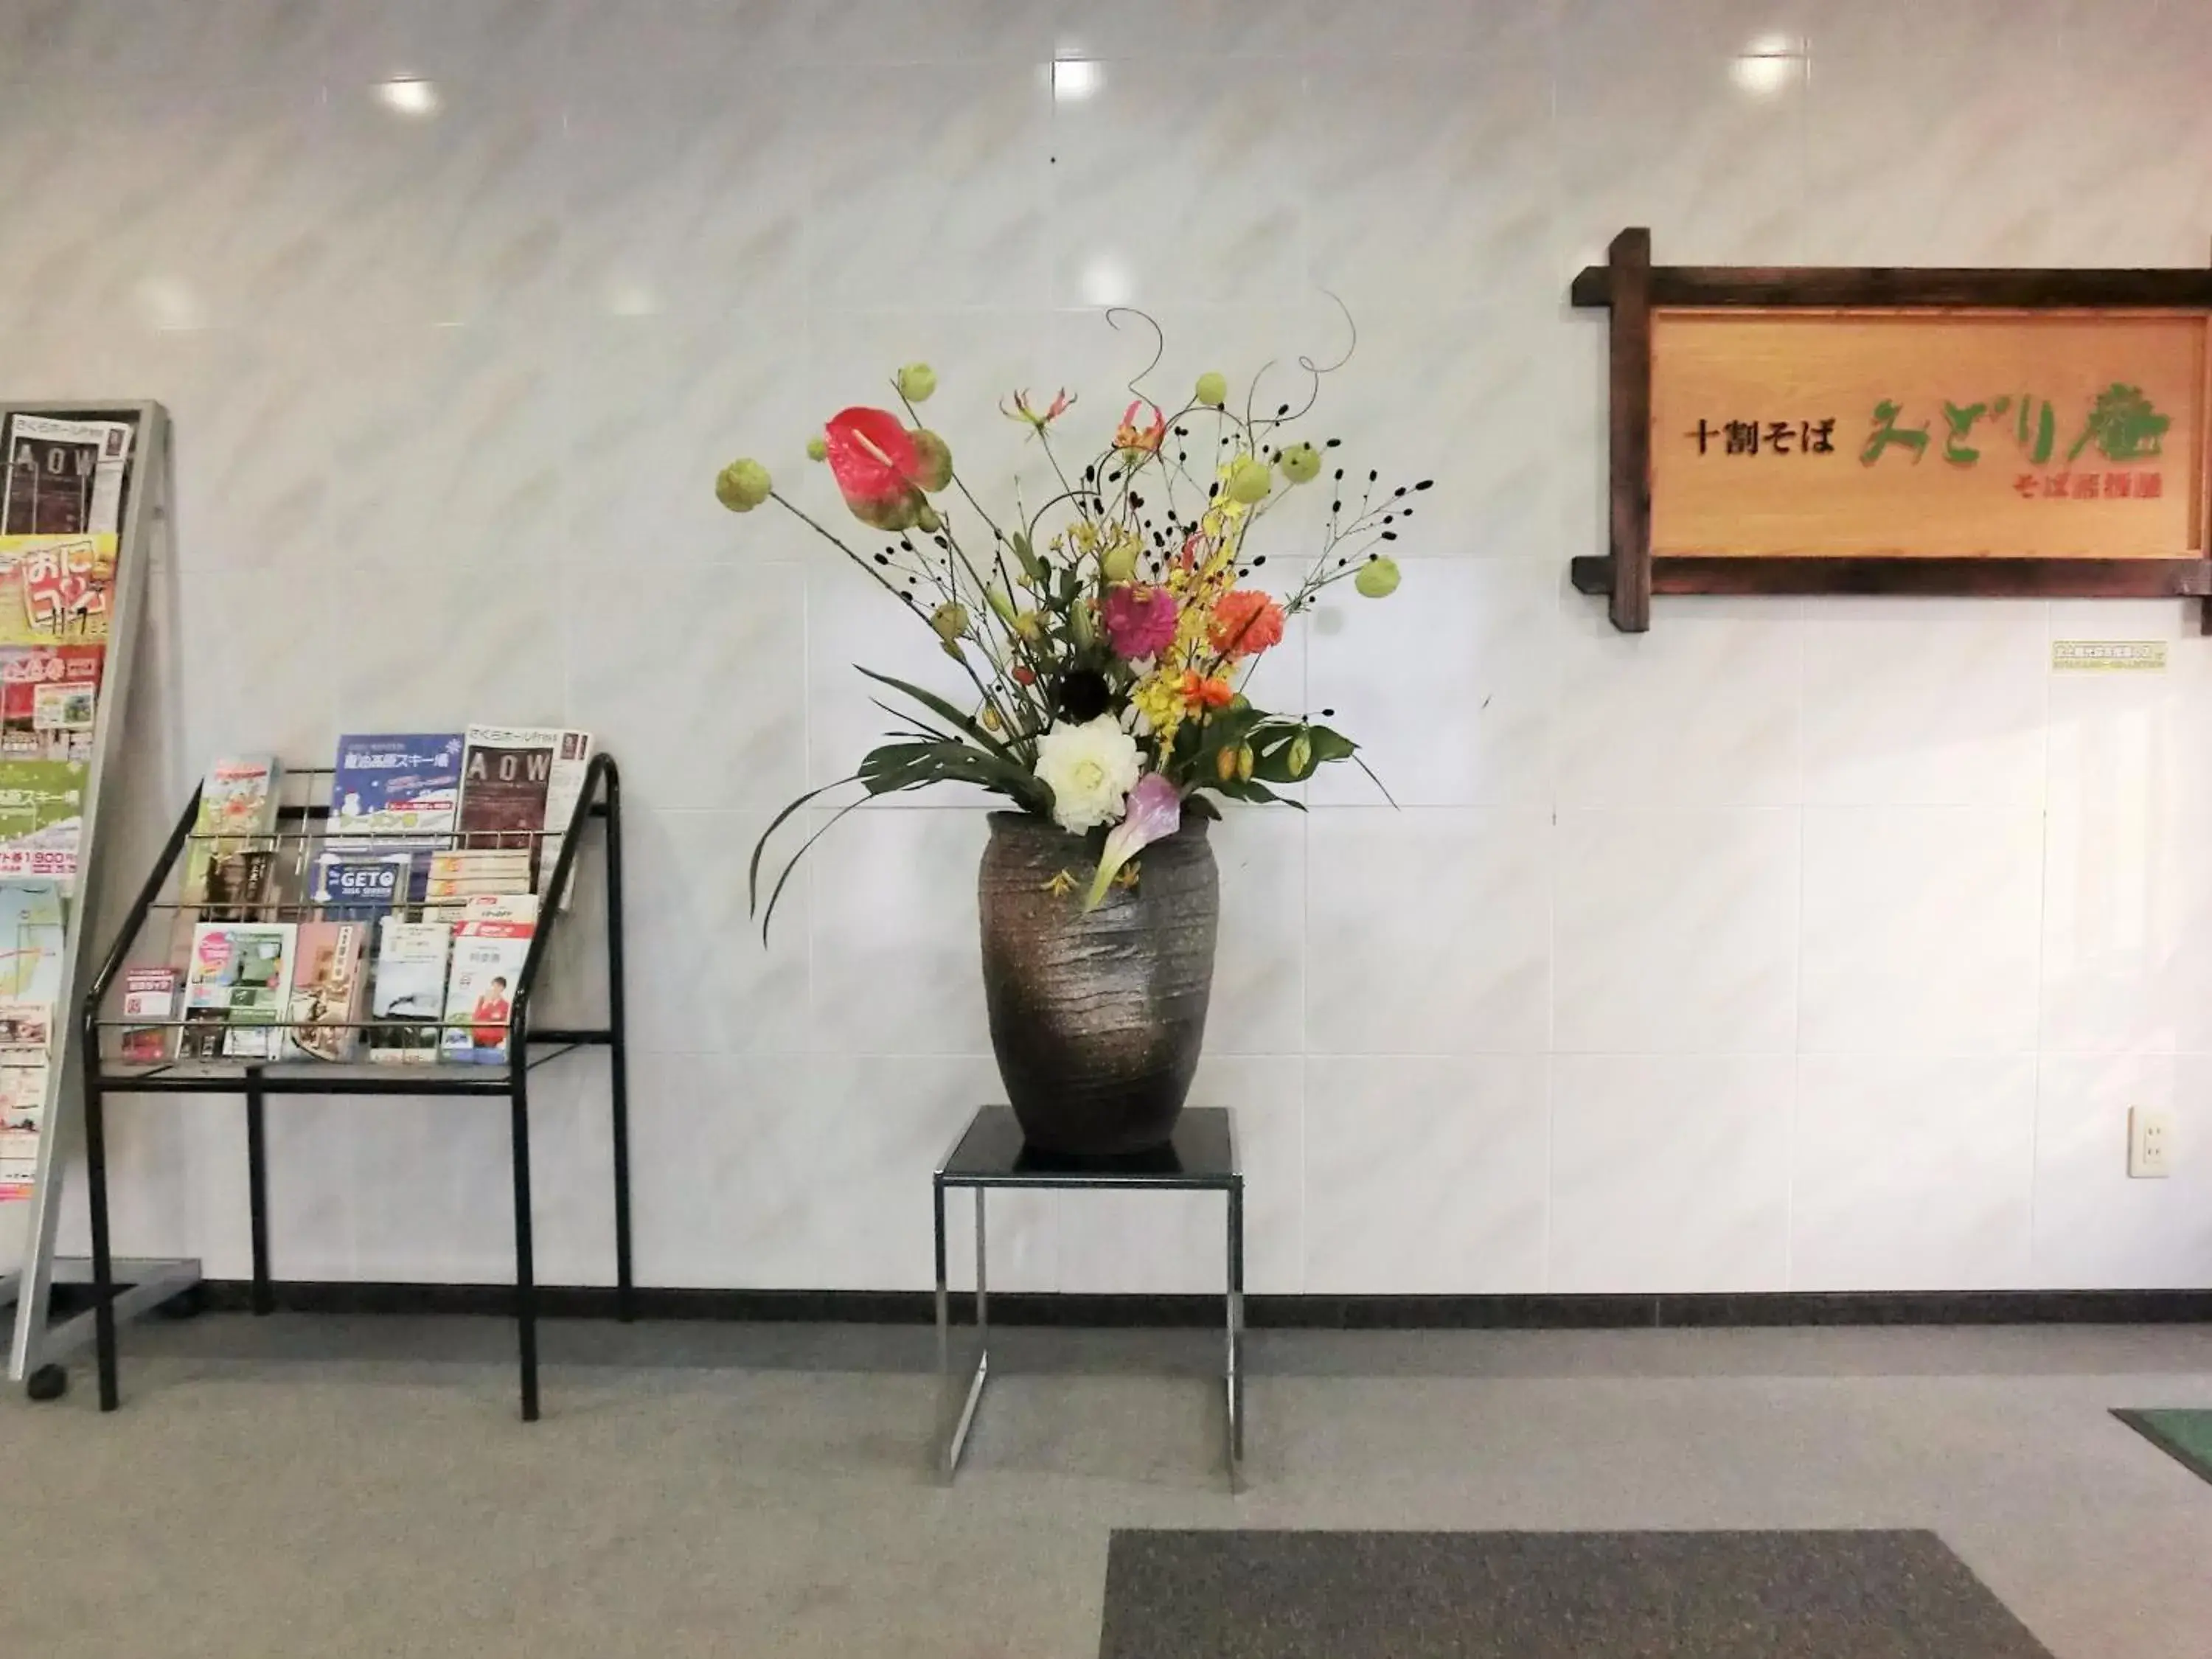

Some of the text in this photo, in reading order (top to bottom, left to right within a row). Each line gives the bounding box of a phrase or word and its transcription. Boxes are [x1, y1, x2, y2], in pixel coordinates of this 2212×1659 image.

[1684, 418, 1837, 456] 十割そば
[466, 751, 552, 782] AOW
[341, 871, 396, 887] GETO
